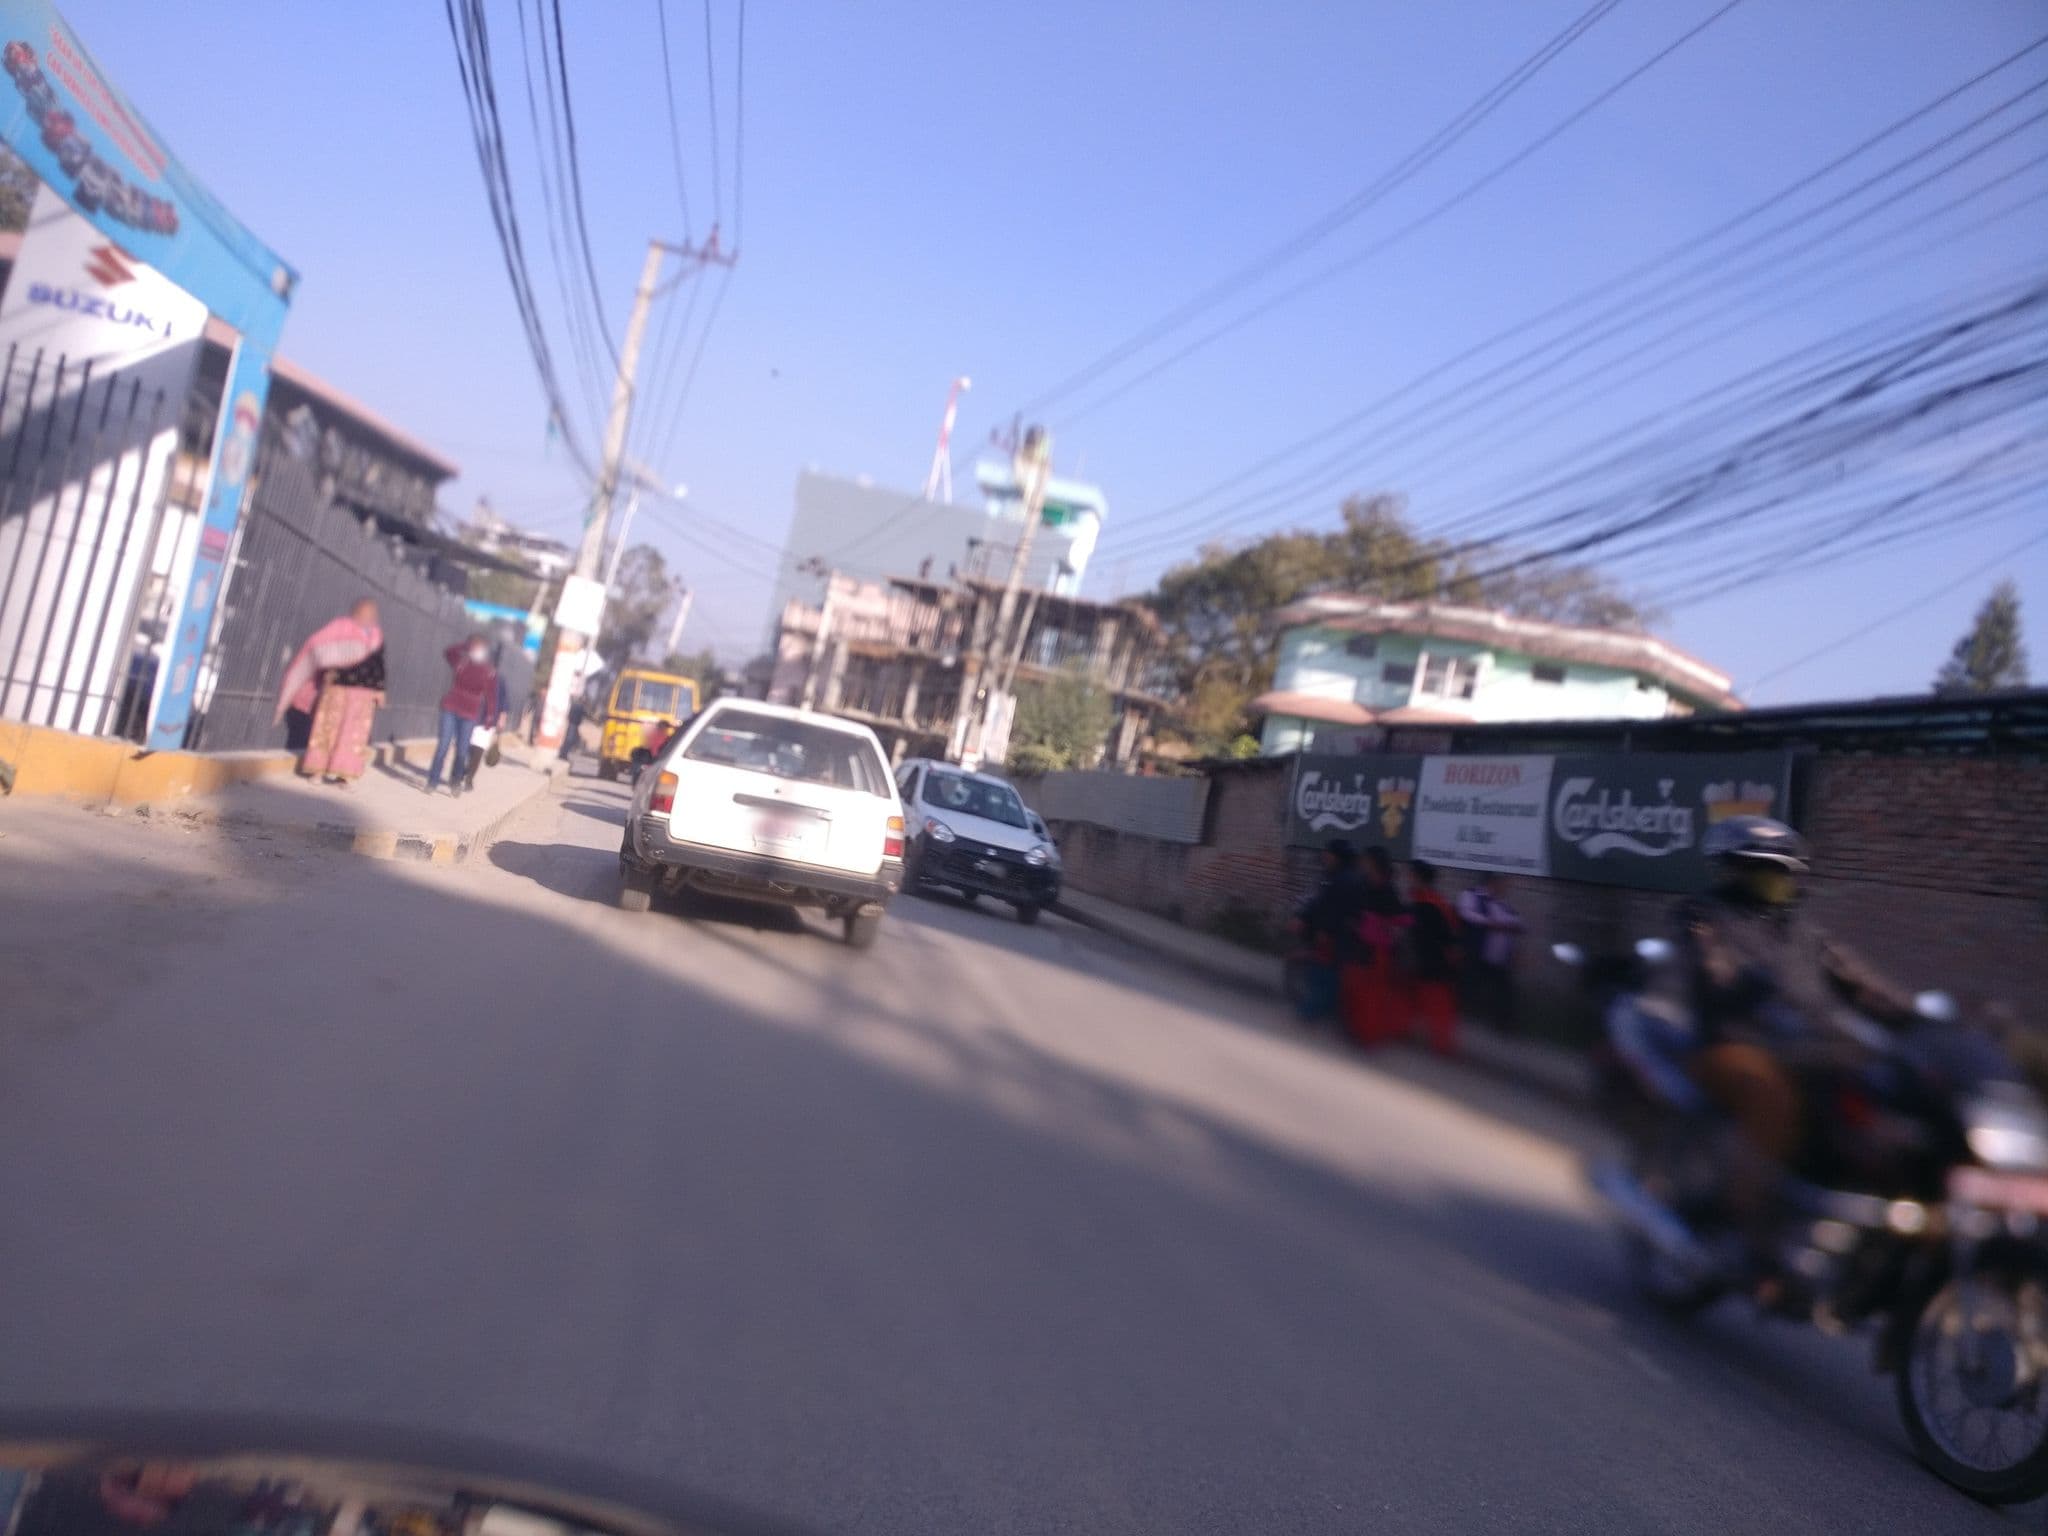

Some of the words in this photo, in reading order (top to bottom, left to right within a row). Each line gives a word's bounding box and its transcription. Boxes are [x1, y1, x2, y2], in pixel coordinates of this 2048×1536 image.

[27, 283, 173, 339] SUZUKI
[1297, 771, 1372, 832] Carlsberg
[1443, 763, 1523, 786] HORIZON
[1554, 777, 1694, 857] Carlsberg
